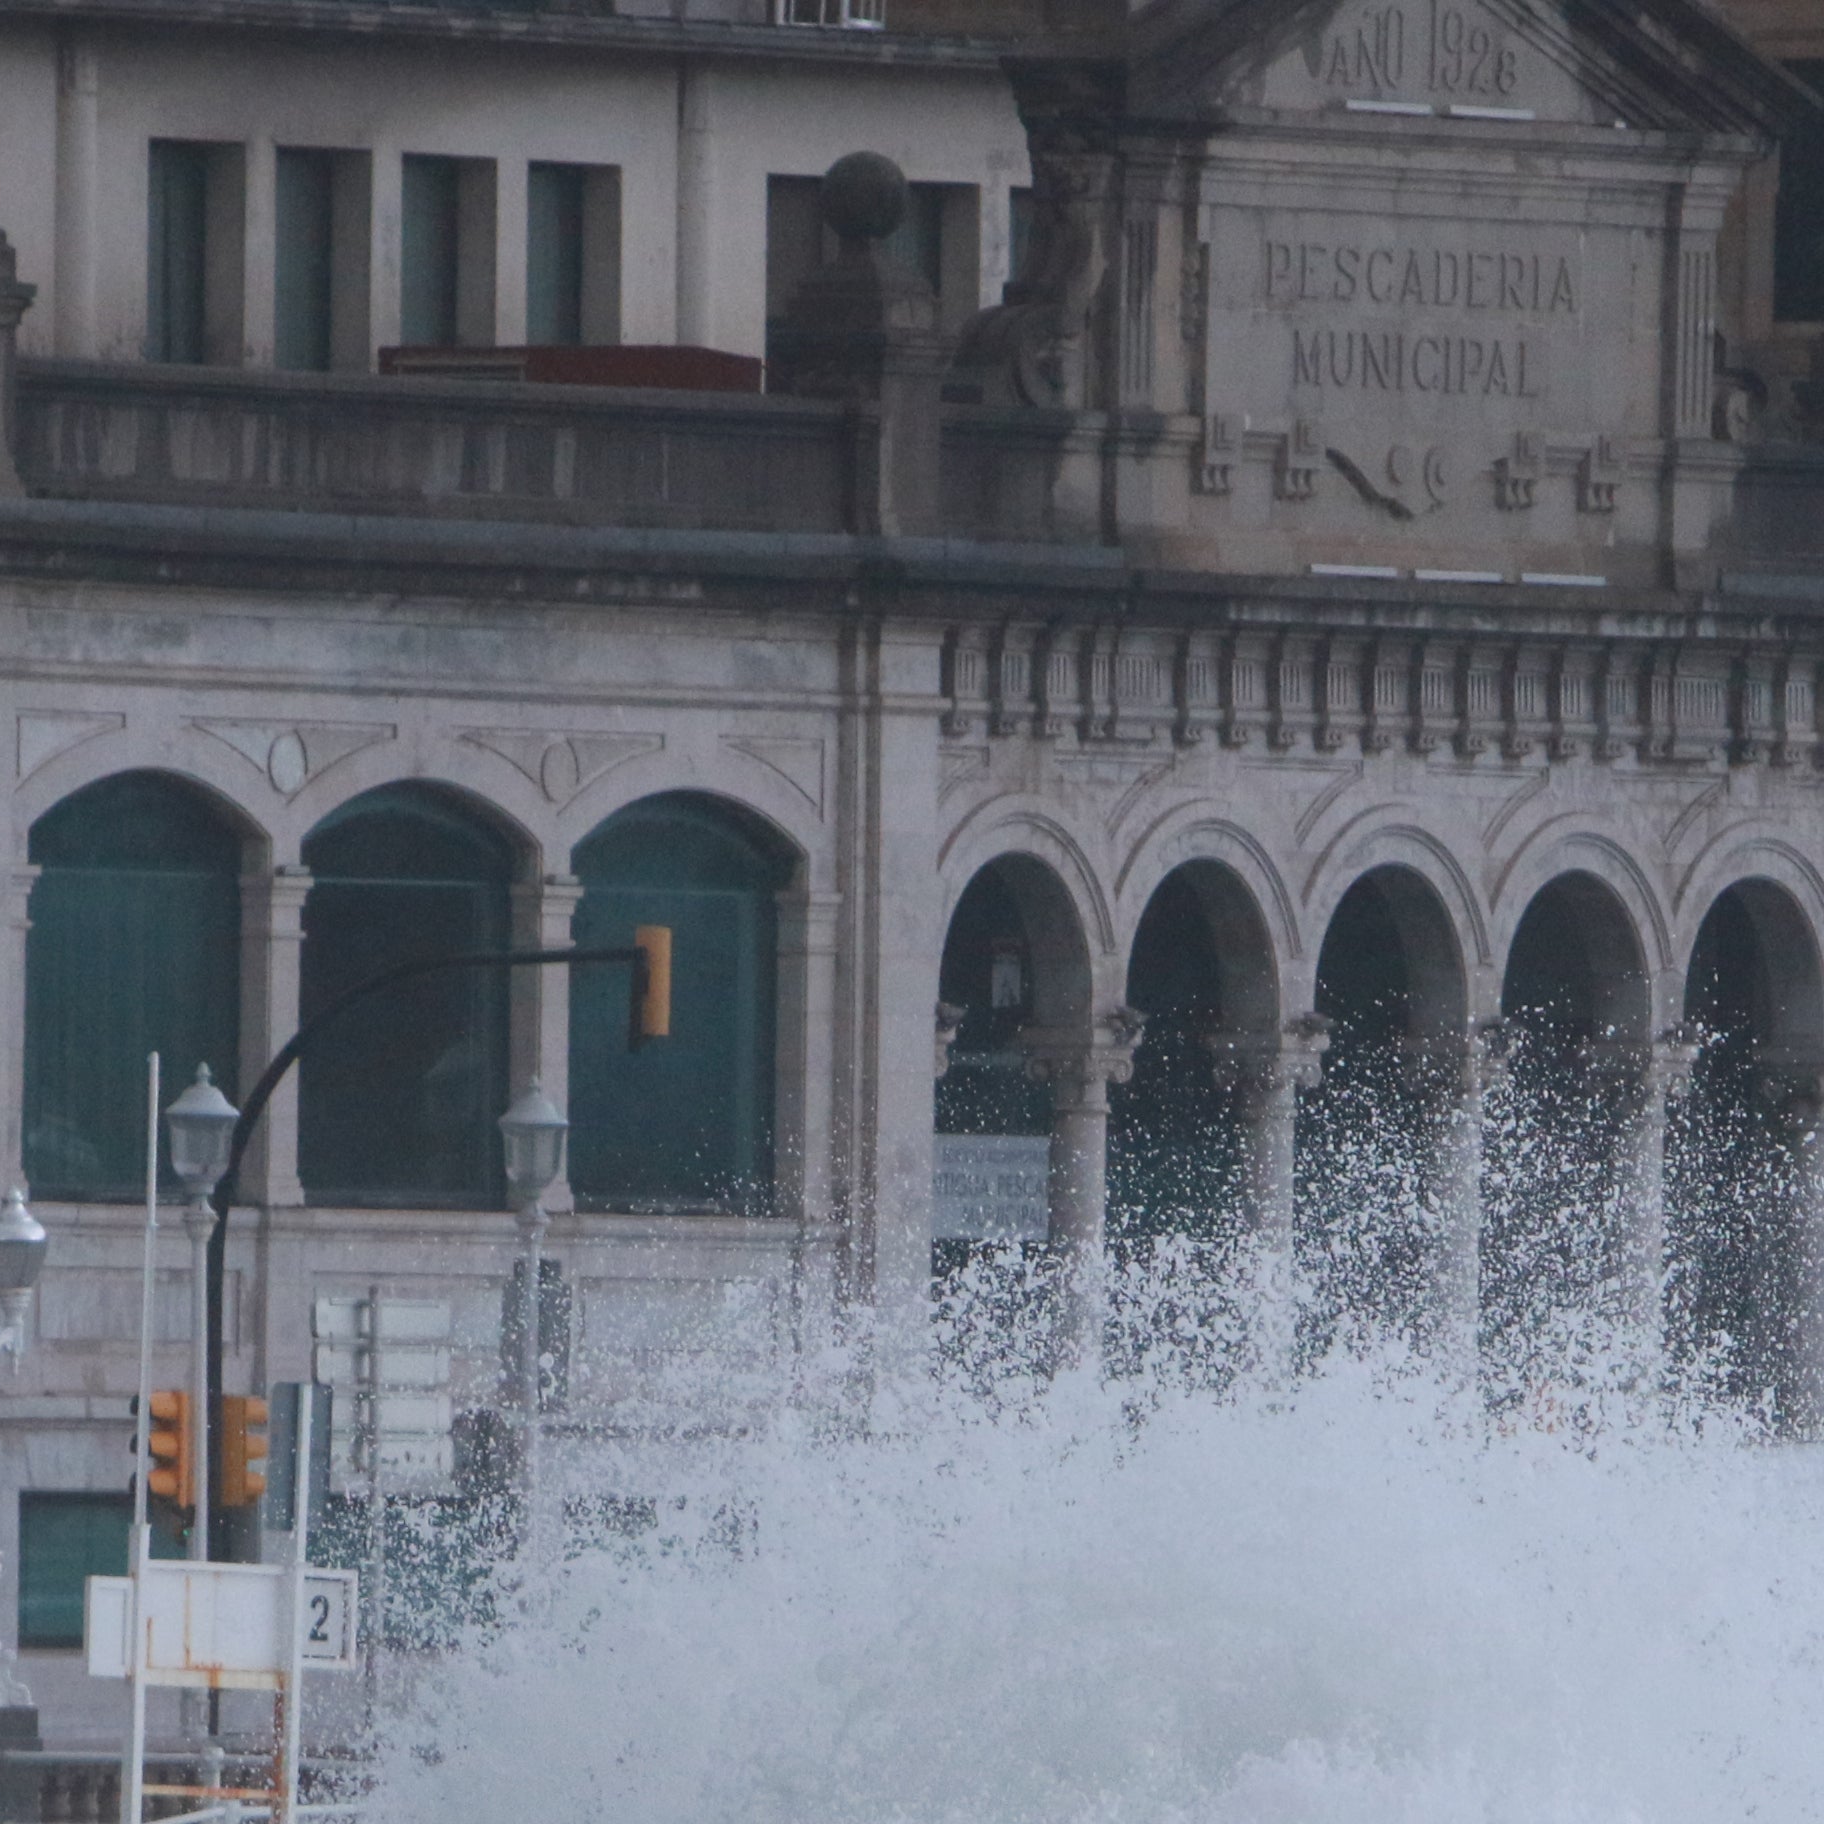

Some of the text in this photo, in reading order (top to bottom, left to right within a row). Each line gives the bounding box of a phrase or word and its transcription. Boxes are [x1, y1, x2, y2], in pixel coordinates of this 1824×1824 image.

[1265, 240, 1575, 314] PESCADERIA
[1292, 328, 1540, 399] MUNICIPAL
[309, 1593, 330, 1641] 2
